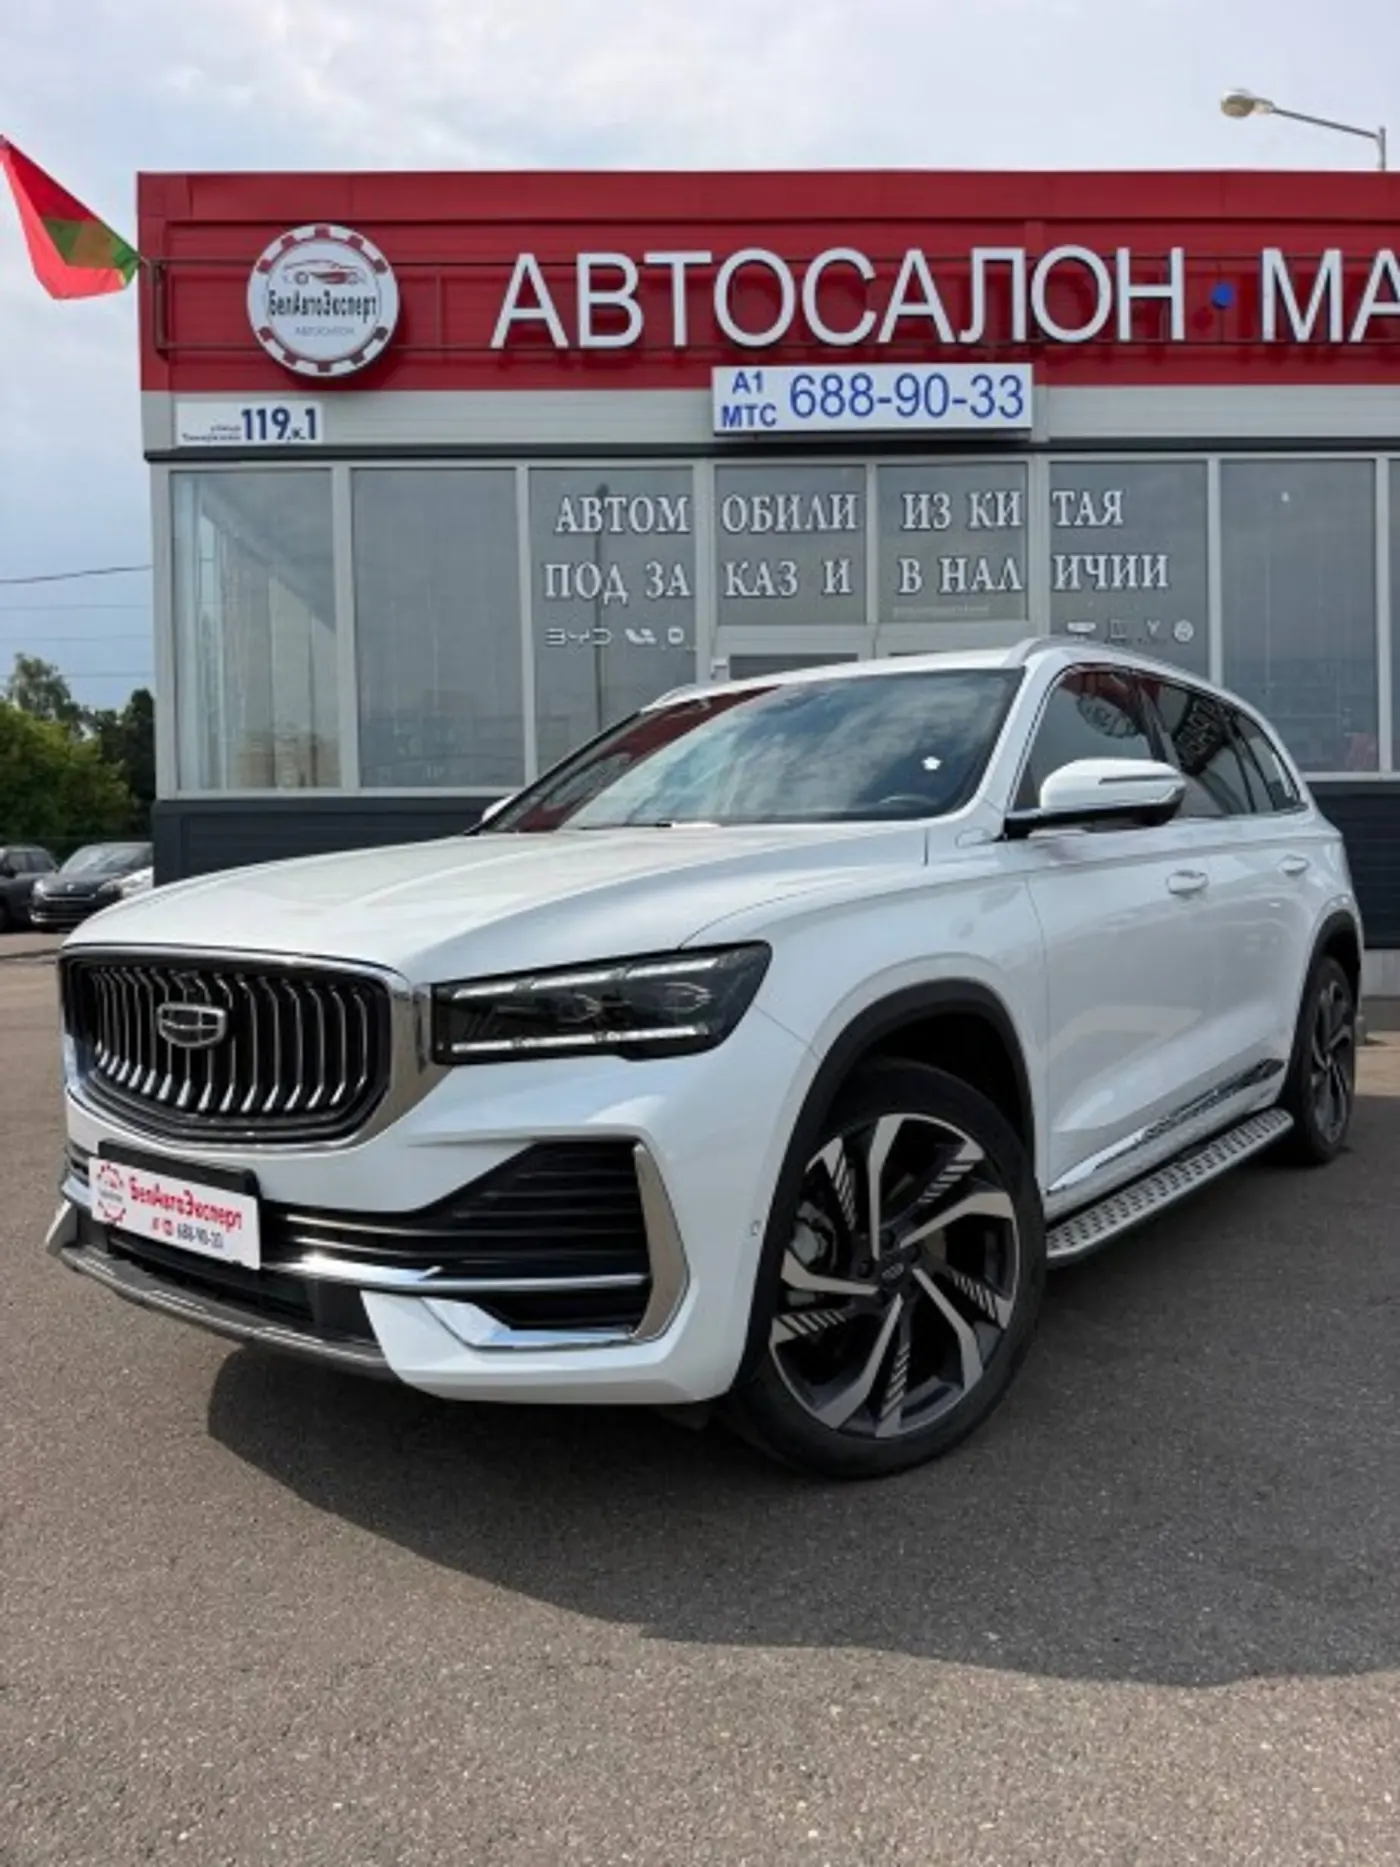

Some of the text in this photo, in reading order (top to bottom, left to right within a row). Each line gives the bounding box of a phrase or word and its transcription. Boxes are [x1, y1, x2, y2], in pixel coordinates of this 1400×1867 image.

[490, 246, 1400, 348] АВТОСАЛОН МА
[722, 404, 777, 428] МТС
[789, 372, 1025, 419] 688-90-33
[903, 493, 951, 529] ИЗ
[545, 563, 628, 604] ПОД
[823, 560, 851, 593] И
[899, 558, 922, 593] В
